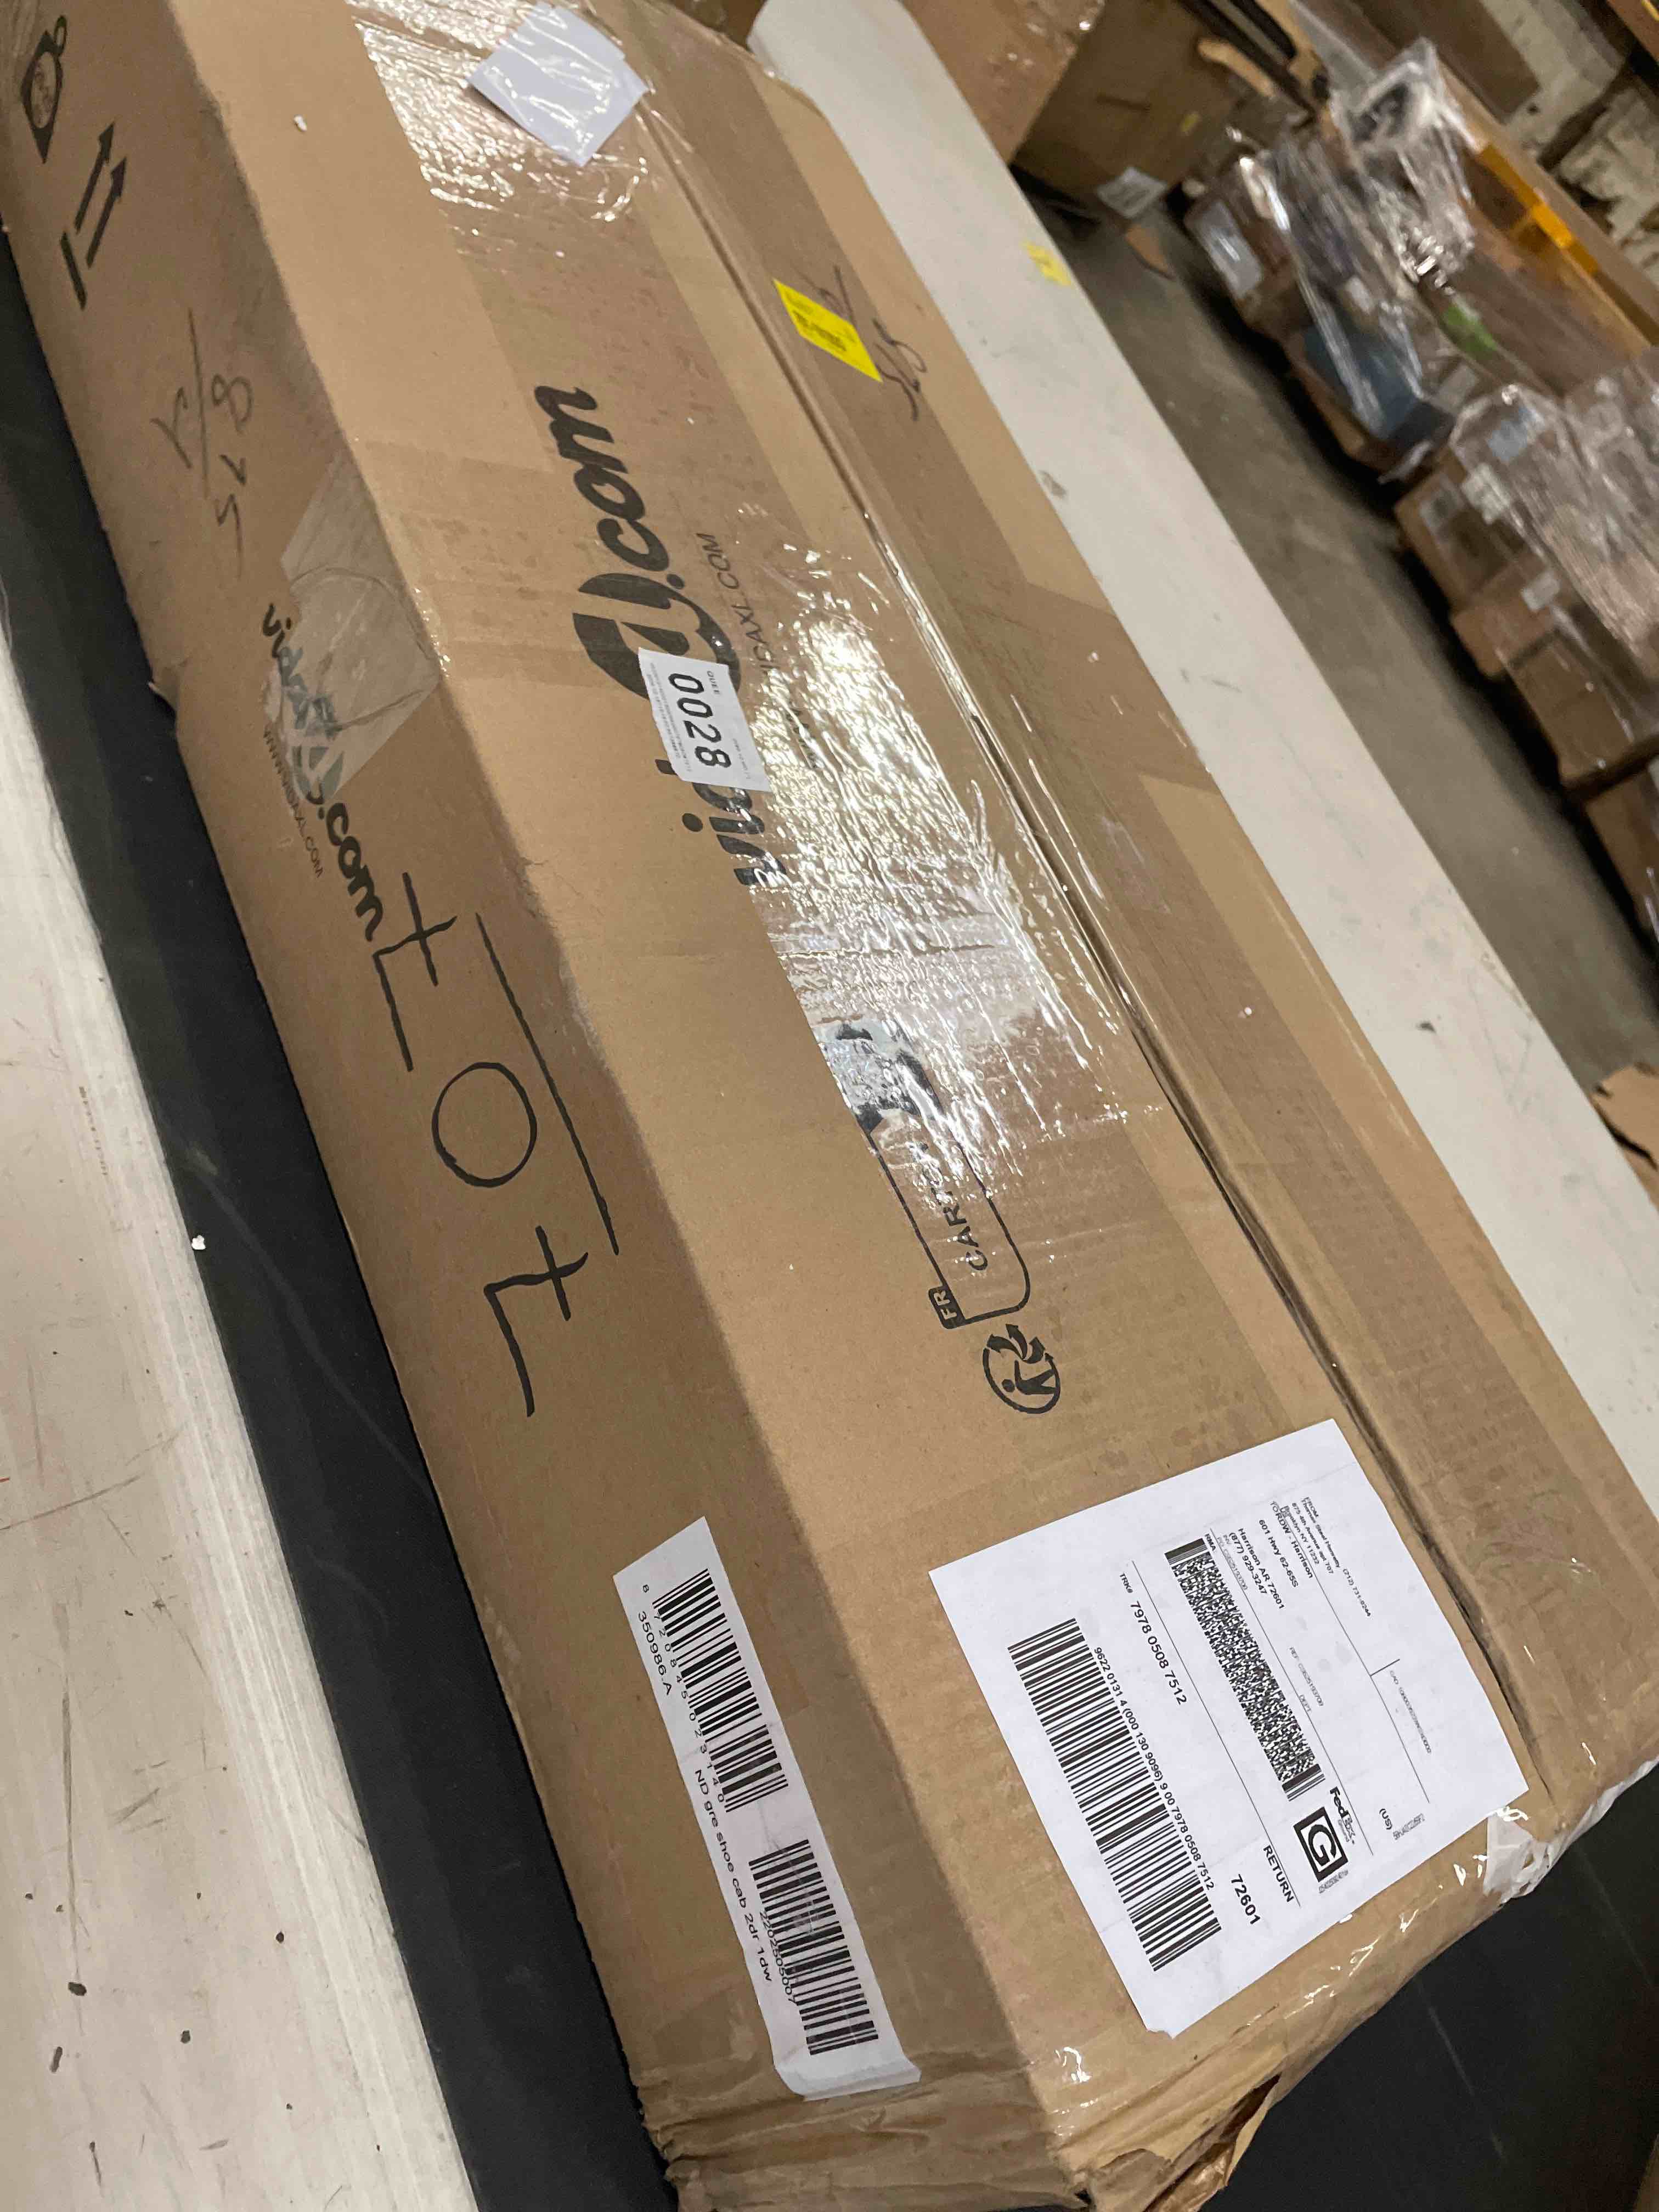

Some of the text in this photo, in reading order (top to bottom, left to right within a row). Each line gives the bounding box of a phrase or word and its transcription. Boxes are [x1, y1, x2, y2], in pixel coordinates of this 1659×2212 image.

[668, 673, 732, 769] 0028
[933, 1290, 957, 1318] FR
[1227, 1531, 1268, 1596] (877) 929-3247
[1237, 1527, 1285, 1610] Harrison AR 72601
[1257, 1519, 1300, 1588] 601 Hwy 62-65S
[1274, 1511, 1291, 1535] RDW
[1290, 1540, 1315, 1579] Harrison
[1299, 1533, 1308, 1544] NY
[1306, 1545, 1320, 1565] 11232
[1304, 1526, 1321, 1550] Avenue
[1324, 1562, 1334, 1575] 707
[636, 1608, 674, 1697] 350986.A
[1128, 1600, 1154, 1635] 7978
[1145, 1634, 1171, 1670] 0508
[1163, 1669, 1189, 1706] 7512
[1092, 1646, 1216, 1891] 9622 0131 4 (000 130 9096) 9 00 7978 0508 7512
[1301, 1819, 1342, 1869] G
[1326, 1785, 1361, 1839] FedEx
[1377, 1807, 1394, 1831] (US)
[693, 1768, 776, 1984] ND gre shoe cab 2dr 1dw
[1228, 1873, 1262, 1926] 72601
[1260, 1844, 1296, 1903] RETURN
